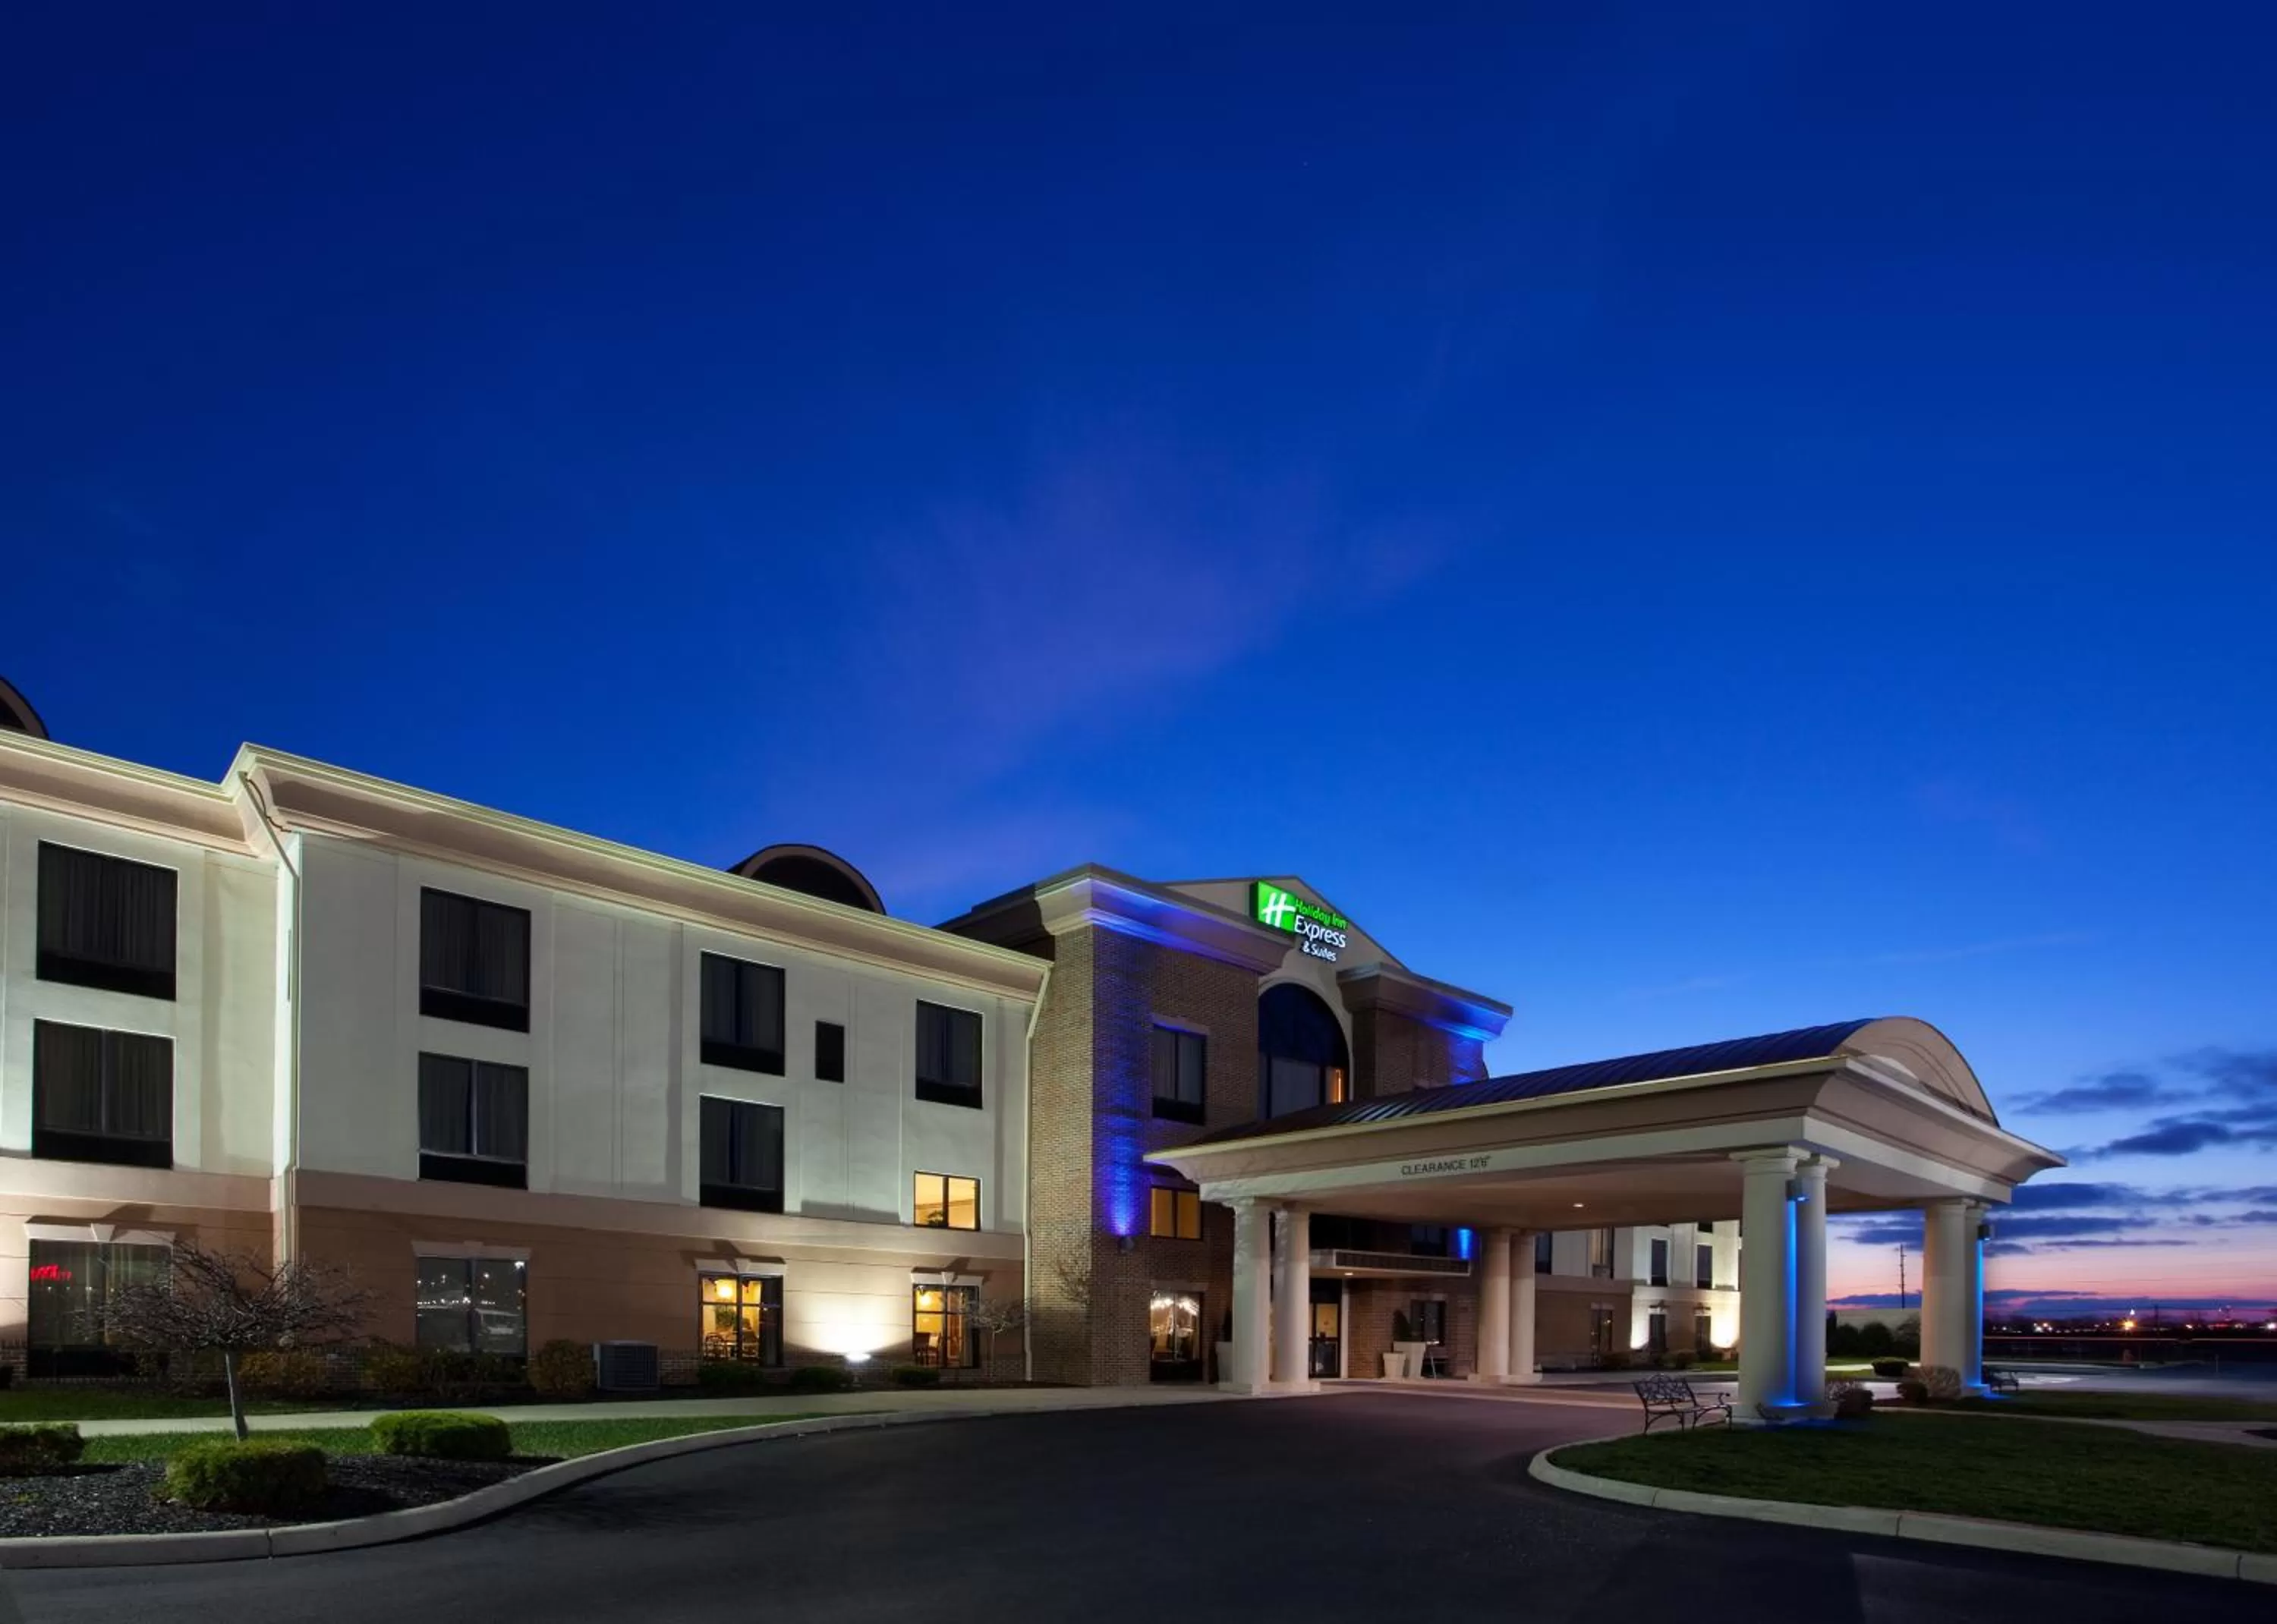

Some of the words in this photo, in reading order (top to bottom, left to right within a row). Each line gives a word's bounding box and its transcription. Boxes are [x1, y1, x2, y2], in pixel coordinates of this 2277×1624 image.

[1296, 899, 1331, 926] Holiday
[1332, 913, 1348, 930] Inn
[1295, 914, 1346, 948] Express
[1302, 941, 1310, 952] &
[1312, 943, 1337, 961] Suites
[1401, 1160, 1467, 1176] CLEARANCE
